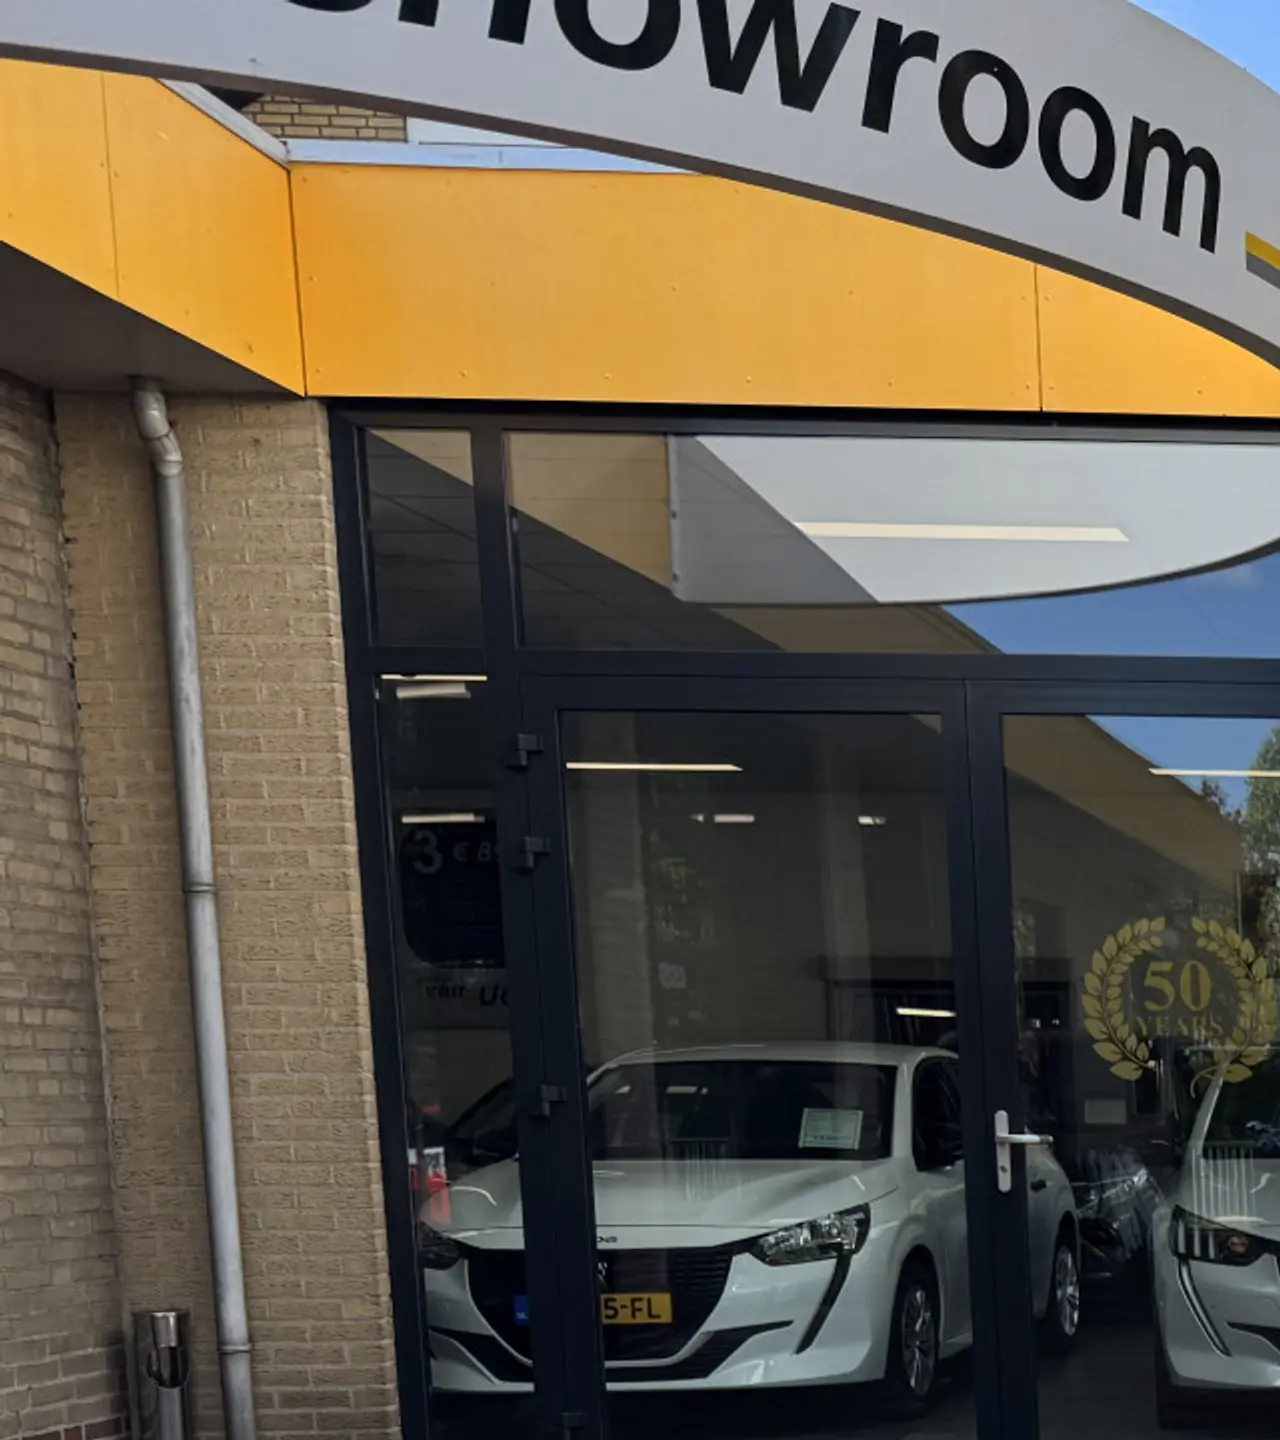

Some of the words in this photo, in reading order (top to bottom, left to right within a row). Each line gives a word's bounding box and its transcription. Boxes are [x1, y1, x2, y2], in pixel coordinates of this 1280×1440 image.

[286, 0, 1221, 254] owroom
[1144, 961, 1211, 1012] 50
[1134, 1015, 1224, 1036] YEARS
[603, 1296, 662, 1320] 5-FL
